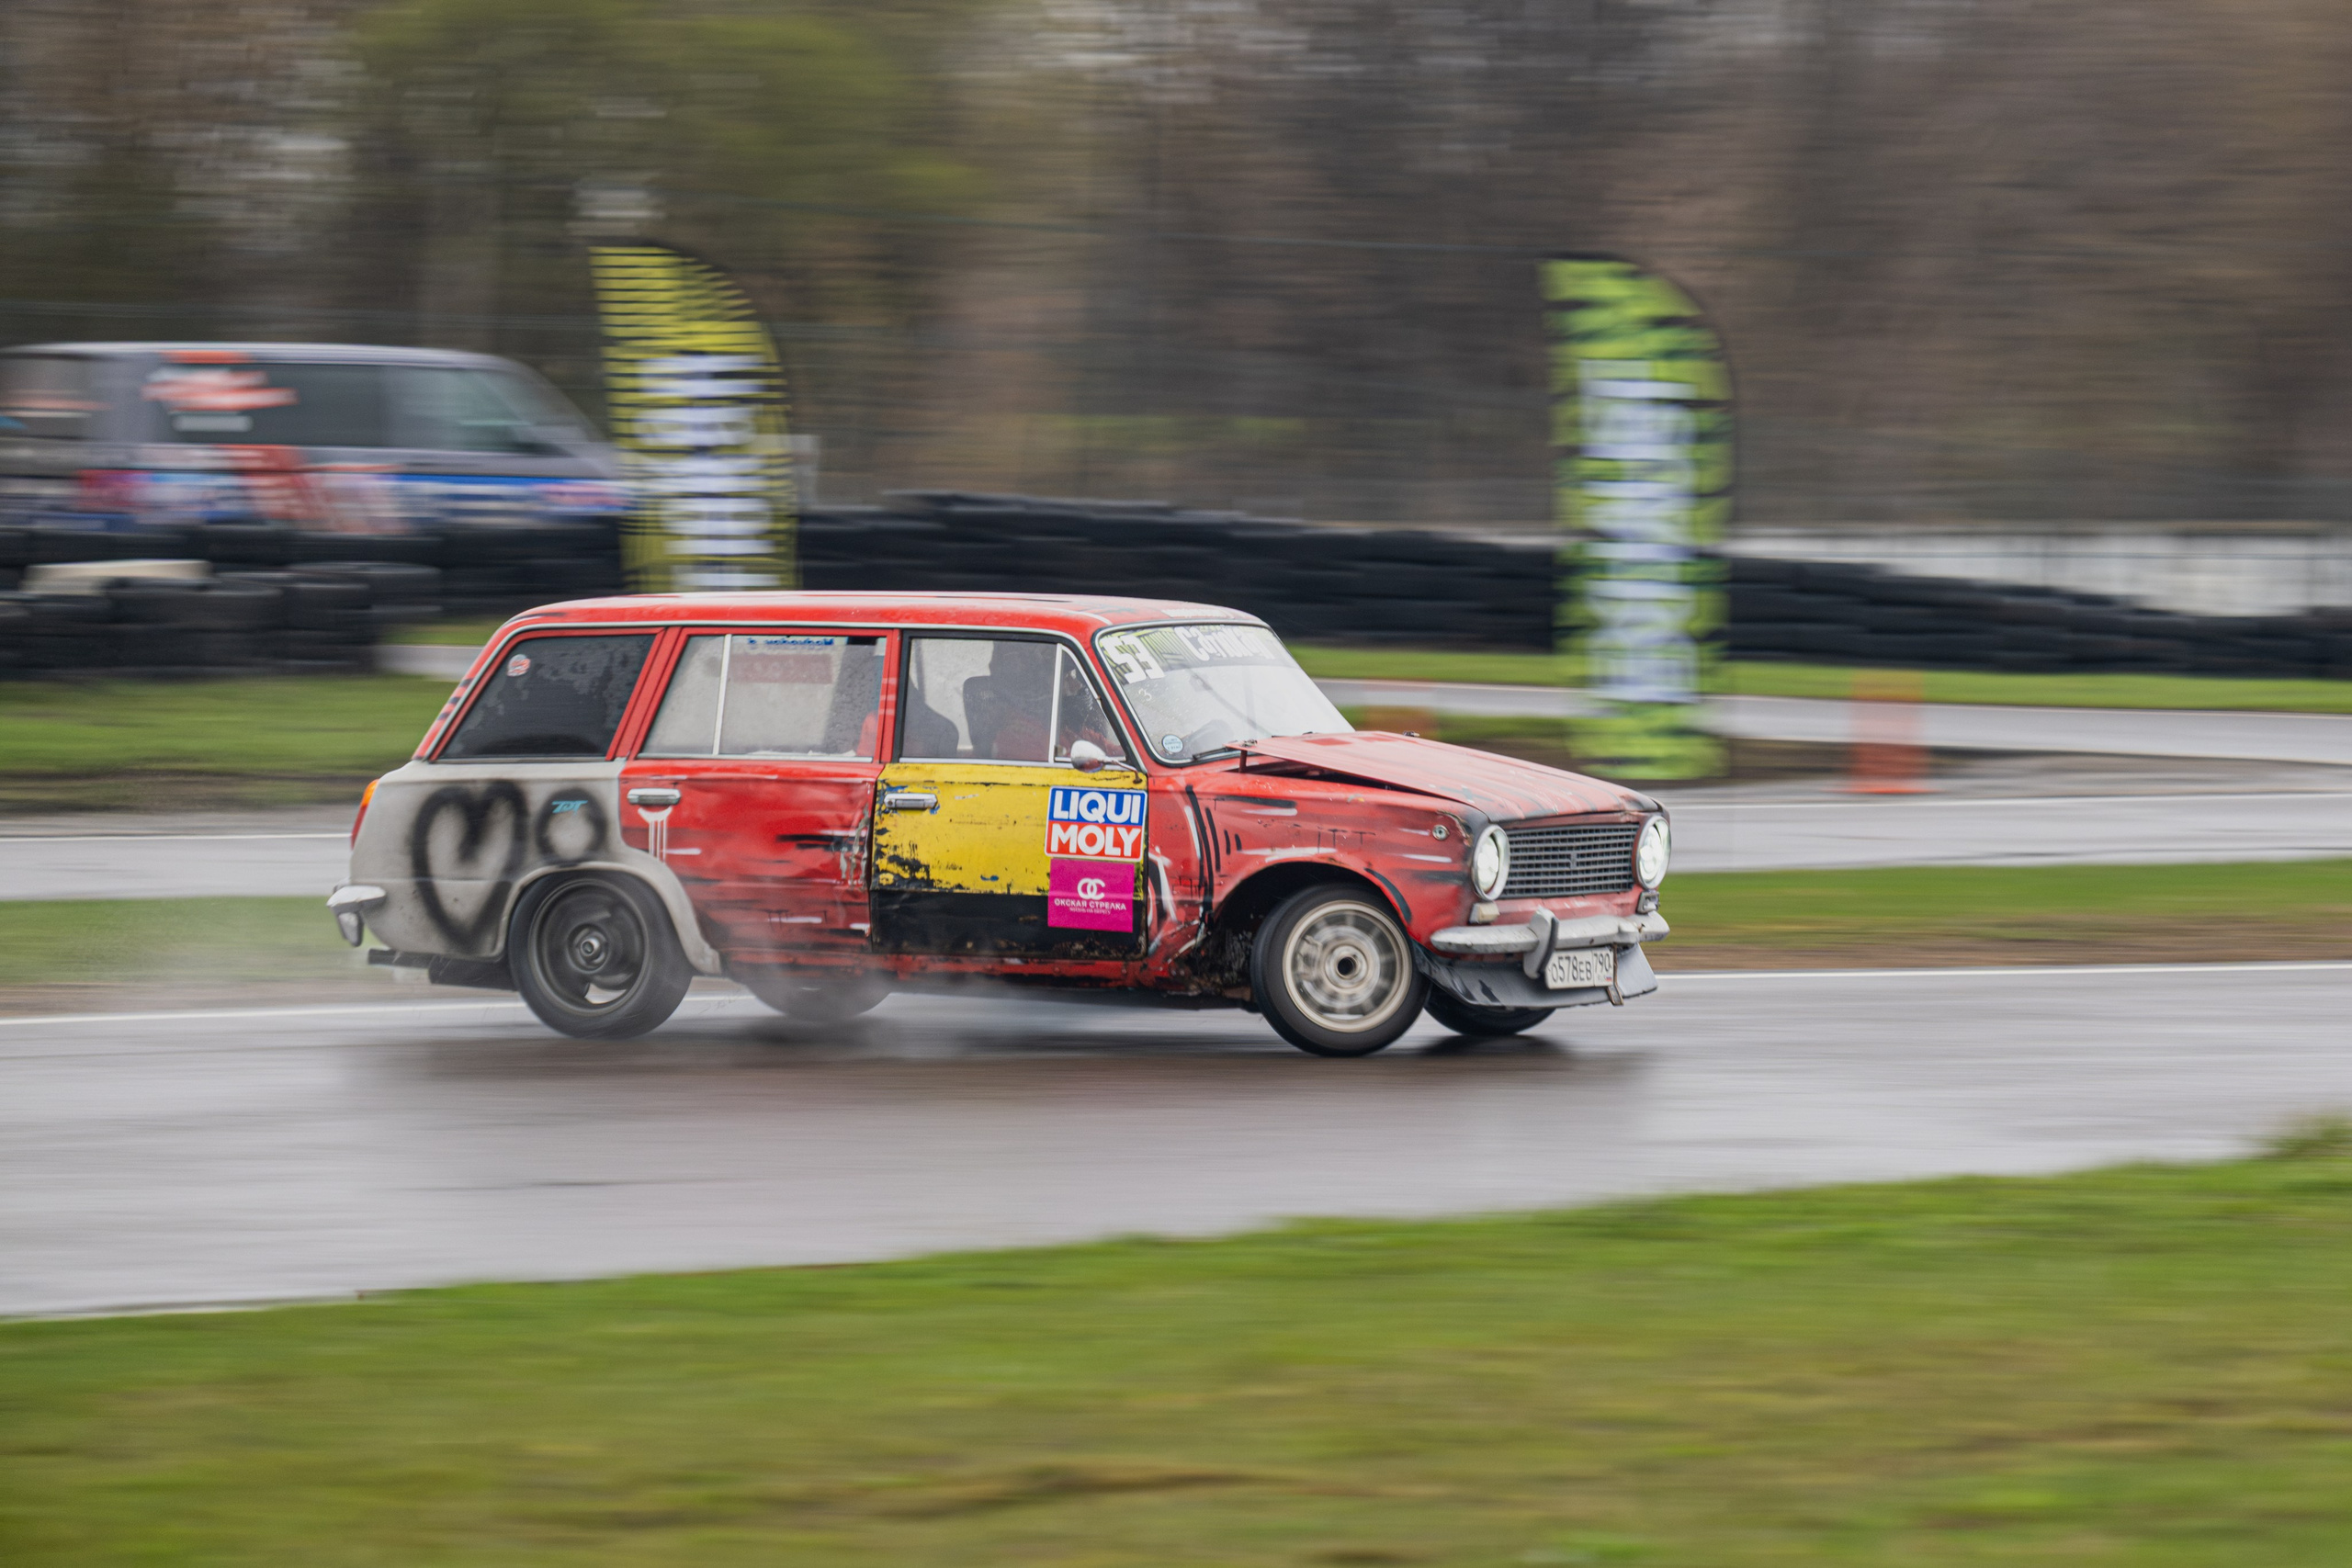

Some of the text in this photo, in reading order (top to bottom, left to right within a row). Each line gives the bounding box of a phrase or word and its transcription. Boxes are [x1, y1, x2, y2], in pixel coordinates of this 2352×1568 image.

[1100, 634, 1166, 684] 53
[1053, 790, 1141, 824] LIQUI
[1050, 823, 1142, 857] MOLY
[1054, 897, 1088, 908] ОКСКАЯ
[1089, 900, 1127, 911] СТРЕЛКА
